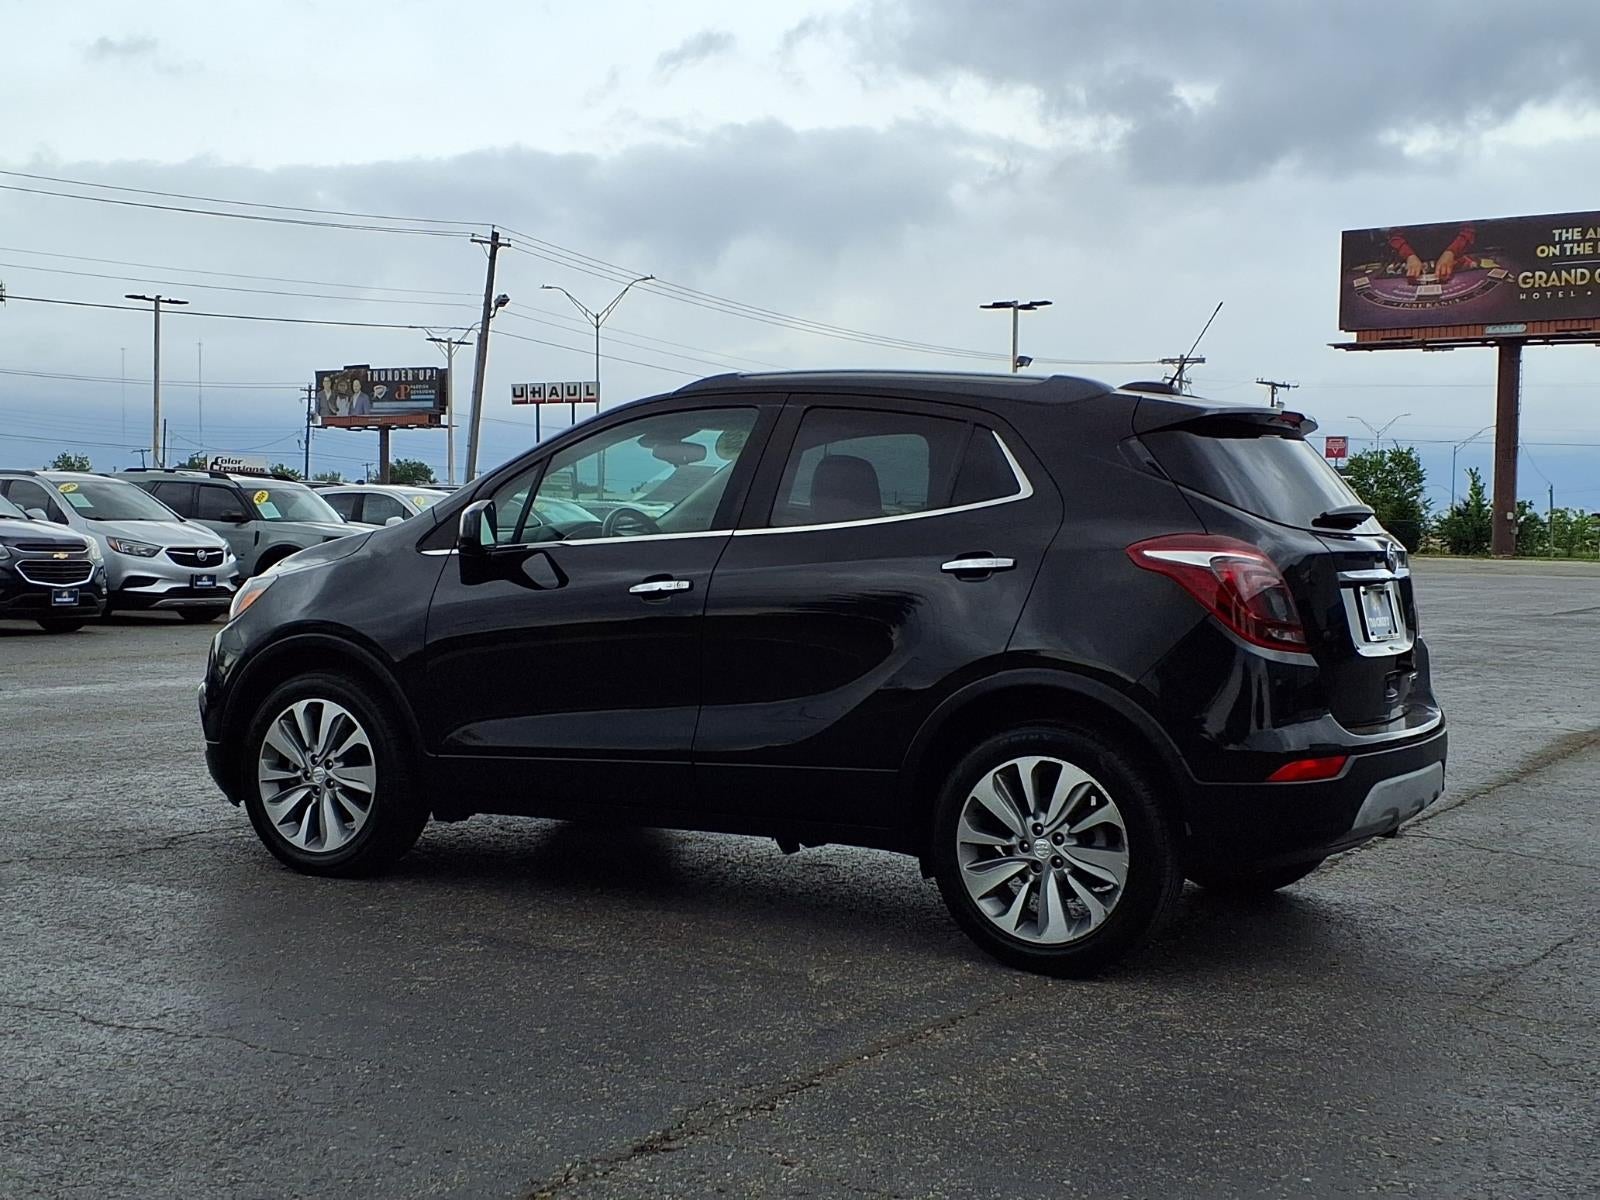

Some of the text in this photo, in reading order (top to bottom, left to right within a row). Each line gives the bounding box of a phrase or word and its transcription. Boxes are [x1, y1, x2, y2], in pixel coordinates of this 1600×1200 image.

[1552, 227, 1583, 242] THE
[1536, 244, 1560, 257] ON
[1563, 242, 1594, 255] THE
[1518, 267, 1591, 289] GRAND
[1520, 290, 1576, 300] HOTEL
[367, 368, 436, 382] THUNDER UP!
[210, 461, 266, 473] Creations
[214, 456, 243, 465] Color
